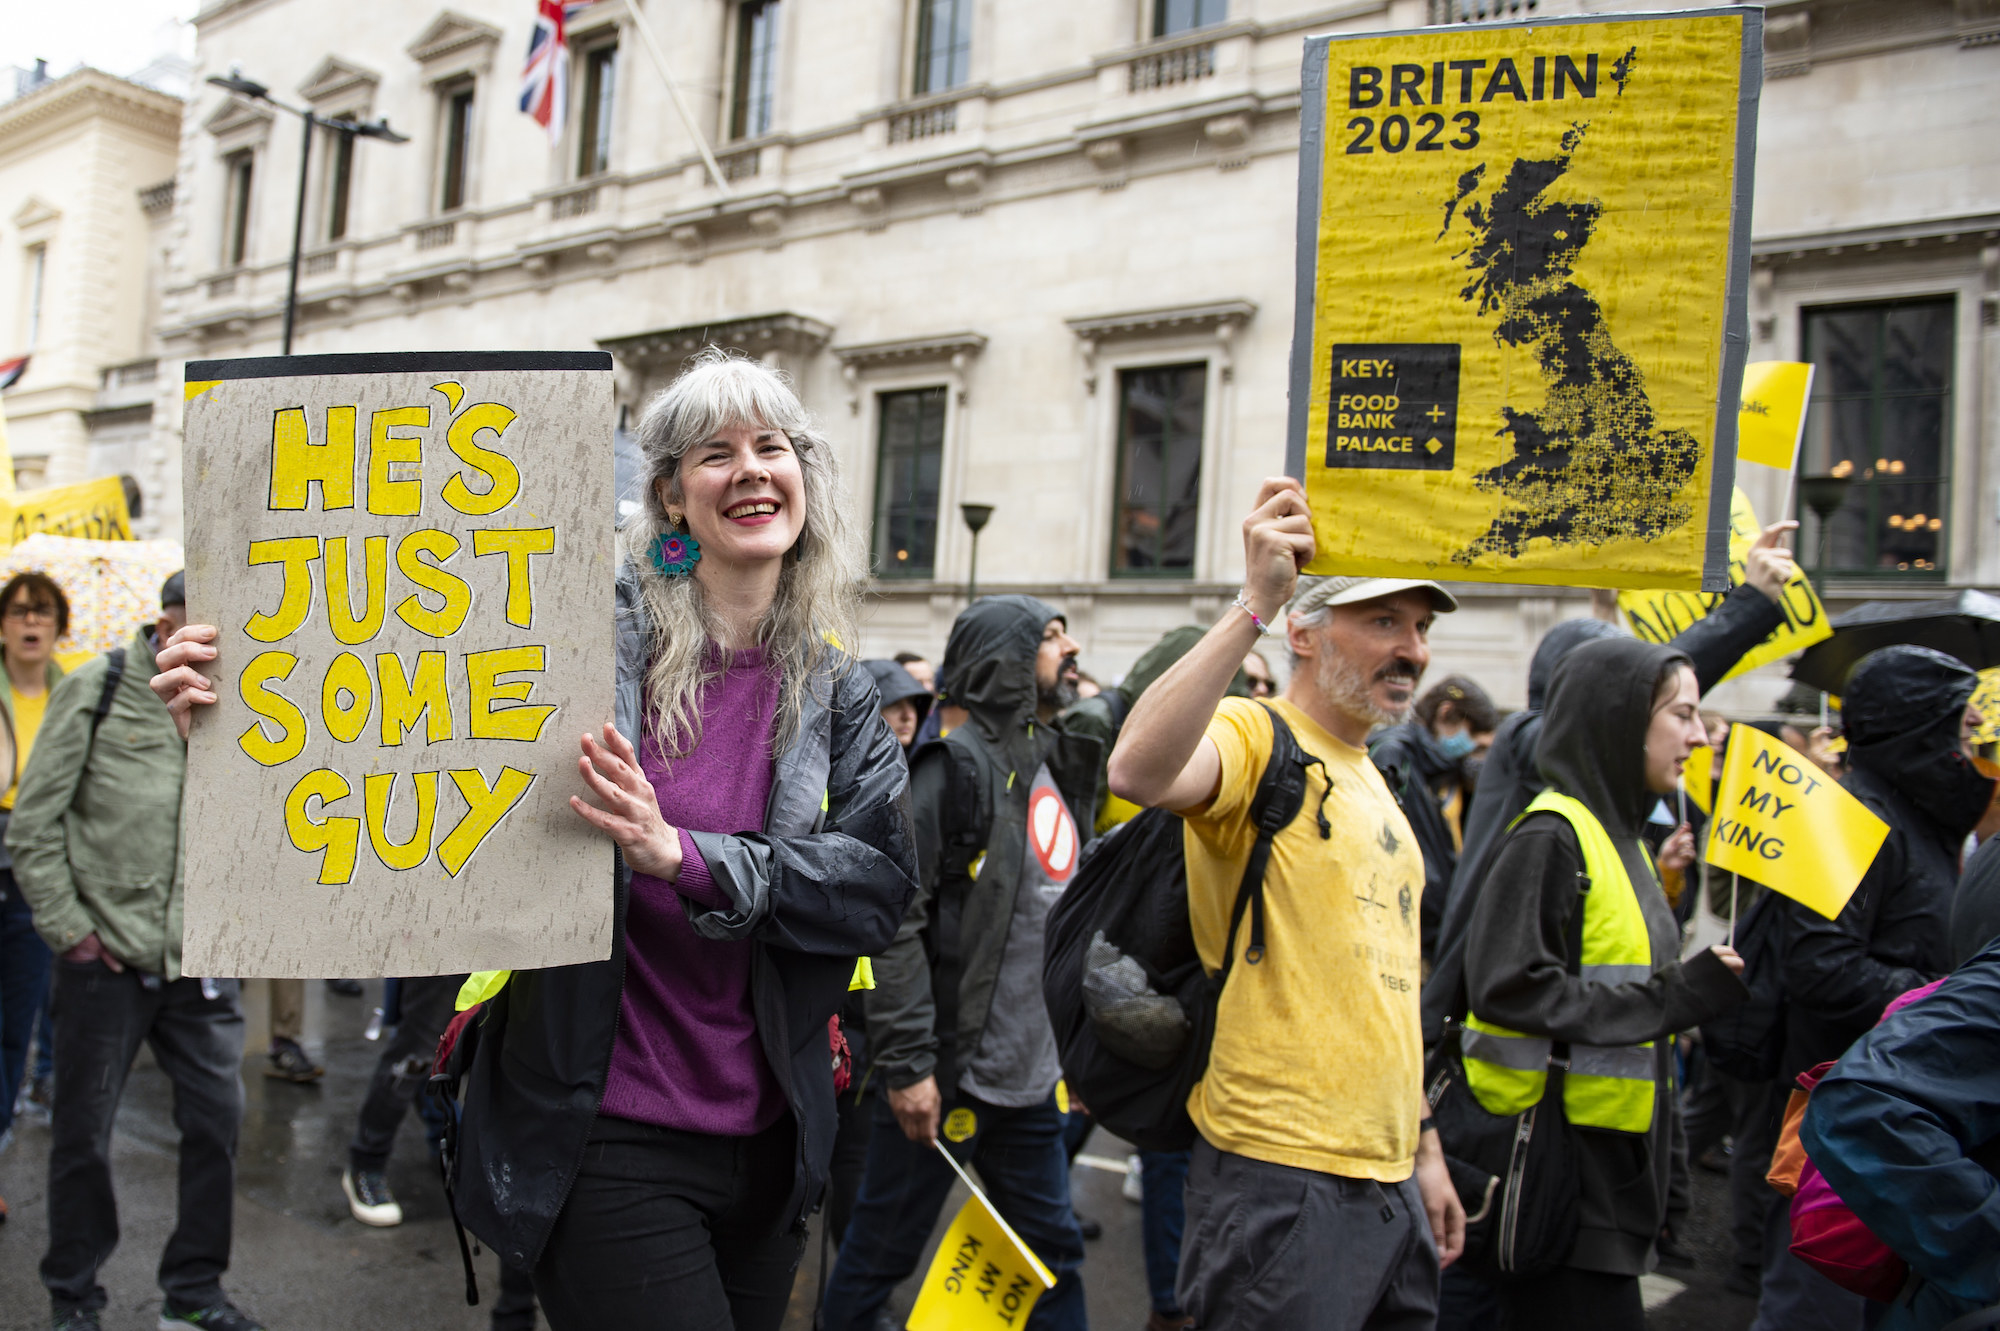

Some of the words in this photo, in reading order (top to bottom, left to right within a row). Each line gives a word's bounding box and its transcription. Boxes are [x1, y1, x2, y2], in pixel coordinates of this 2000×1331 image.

[1349, 53, 1599, 110] BRITAIN
[1346, 111, 1481, 155] 2023
[1341, 359, 1394, 378] KEY:
[1337, 413, 1396, 430] BANK
[1339, 394, 1400, 411] FOOD
[268, 380, 522, 517] HE'S
[1336, 435, 1414, 453] PALACE
[243, 527, 558, 646] JUST
[238, 645, 559, 767] SOME
[1752, 749, 1823, 796] NOT
[284, 765, 538, 885] GUY
[1739, 785, 1795, 820] MY
[1713, 817, 1785, 860] KING
[944, 1233, 984, 1295] KING
[975, 1261, 1004, 1303] MY
[997, 1273, 1034, 1327] NOT
